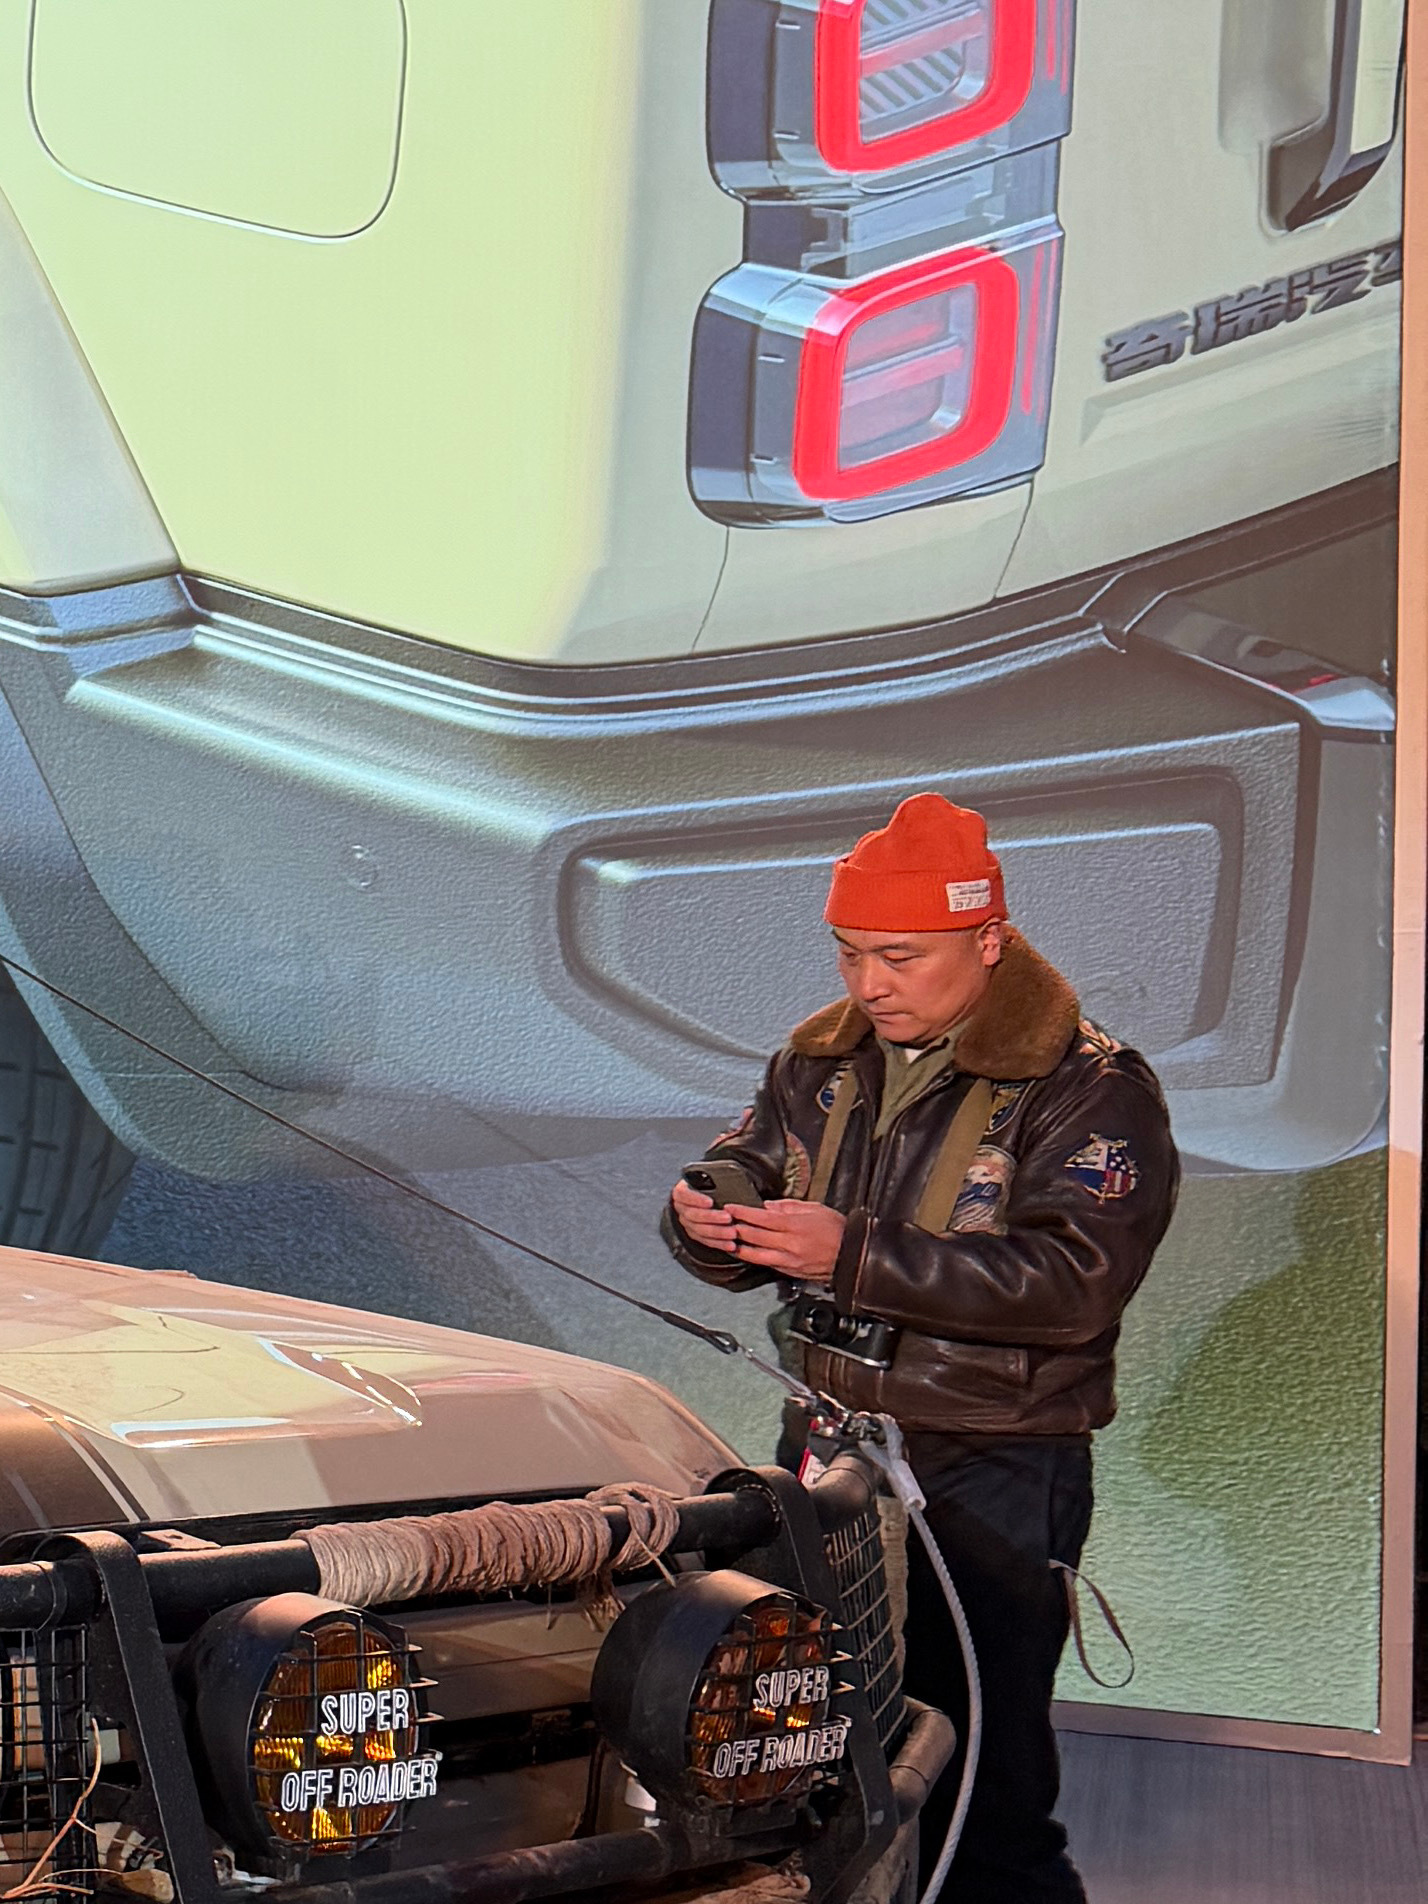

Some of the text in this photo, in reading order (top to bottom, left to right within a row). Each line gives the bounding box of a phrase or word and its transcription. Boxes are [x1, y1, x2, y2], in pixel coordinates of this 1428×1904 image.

[320, 1688, 410, 1736] SUPER
[753, 1665, 830, 1708] SUPER
[713, 1724, 848, 1779] OFF ROADER
[280, 1758, 438, 1812] OFF ROADER
